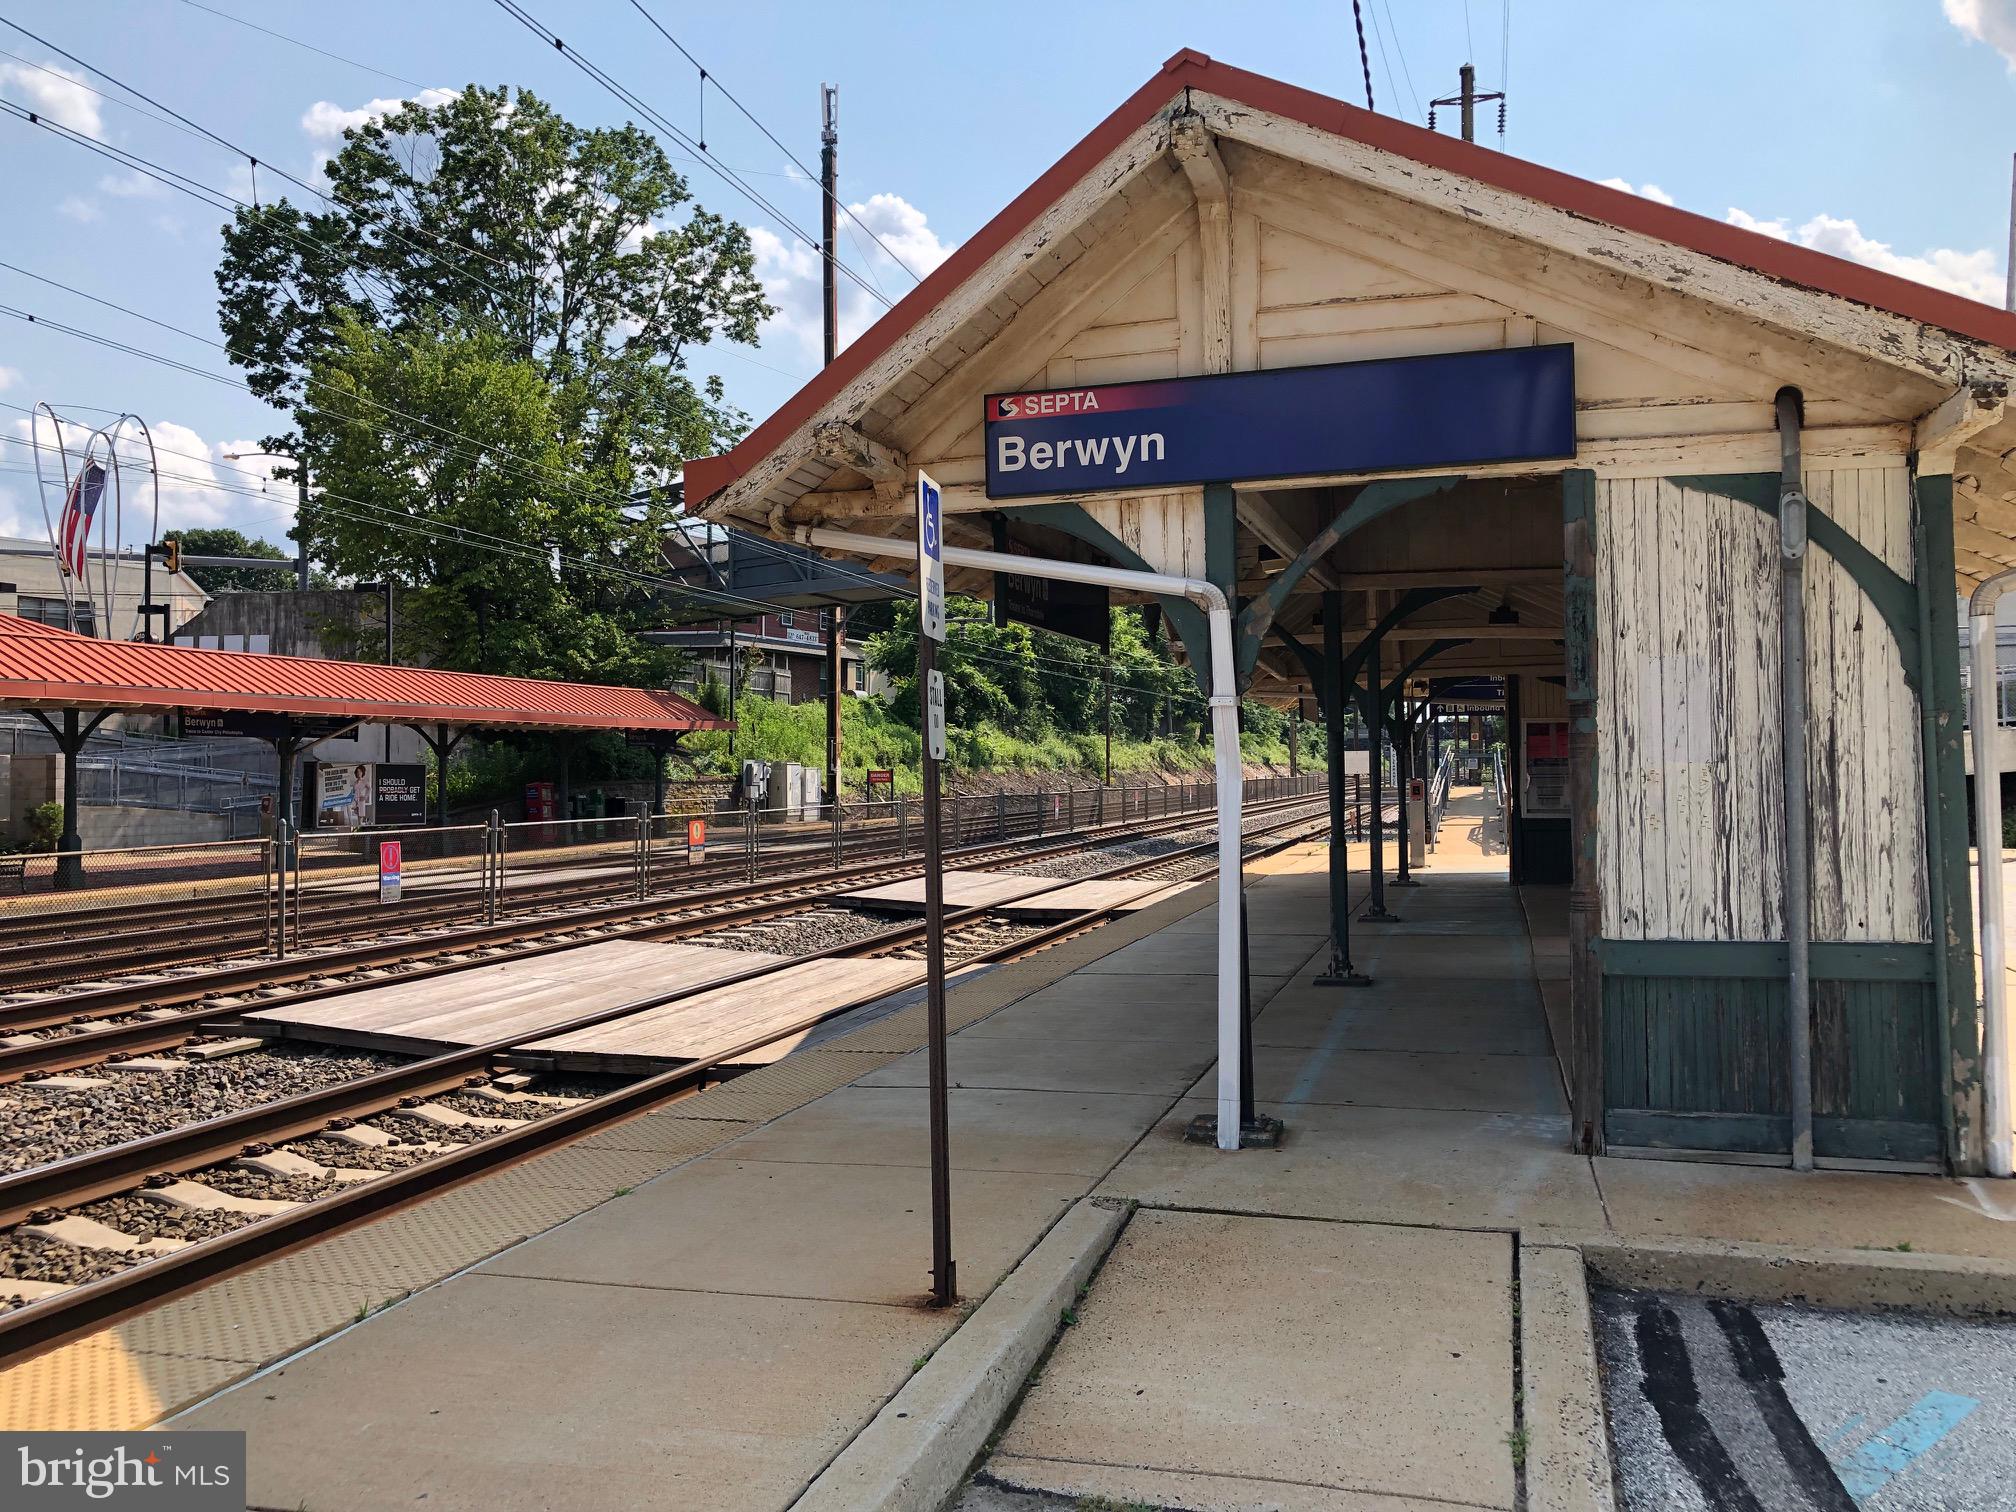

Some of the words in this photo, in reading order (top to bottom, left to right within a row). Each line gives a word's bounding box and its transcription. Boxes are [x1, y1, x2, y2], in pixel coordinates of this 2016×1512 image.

[1024, 391, 1099, 415] SEPTA
[998, 432, 1165, 474] Berwyn
[929, 686, 943, 707] STALL
[184, 717, 216, 729] Berwyn
[379, 786, 408, 794] PROBABLY
[409, 786, 420, 794] GET
[384, 794, 398, 802] RIDE
[399, 794, 418, 802] HOME.
